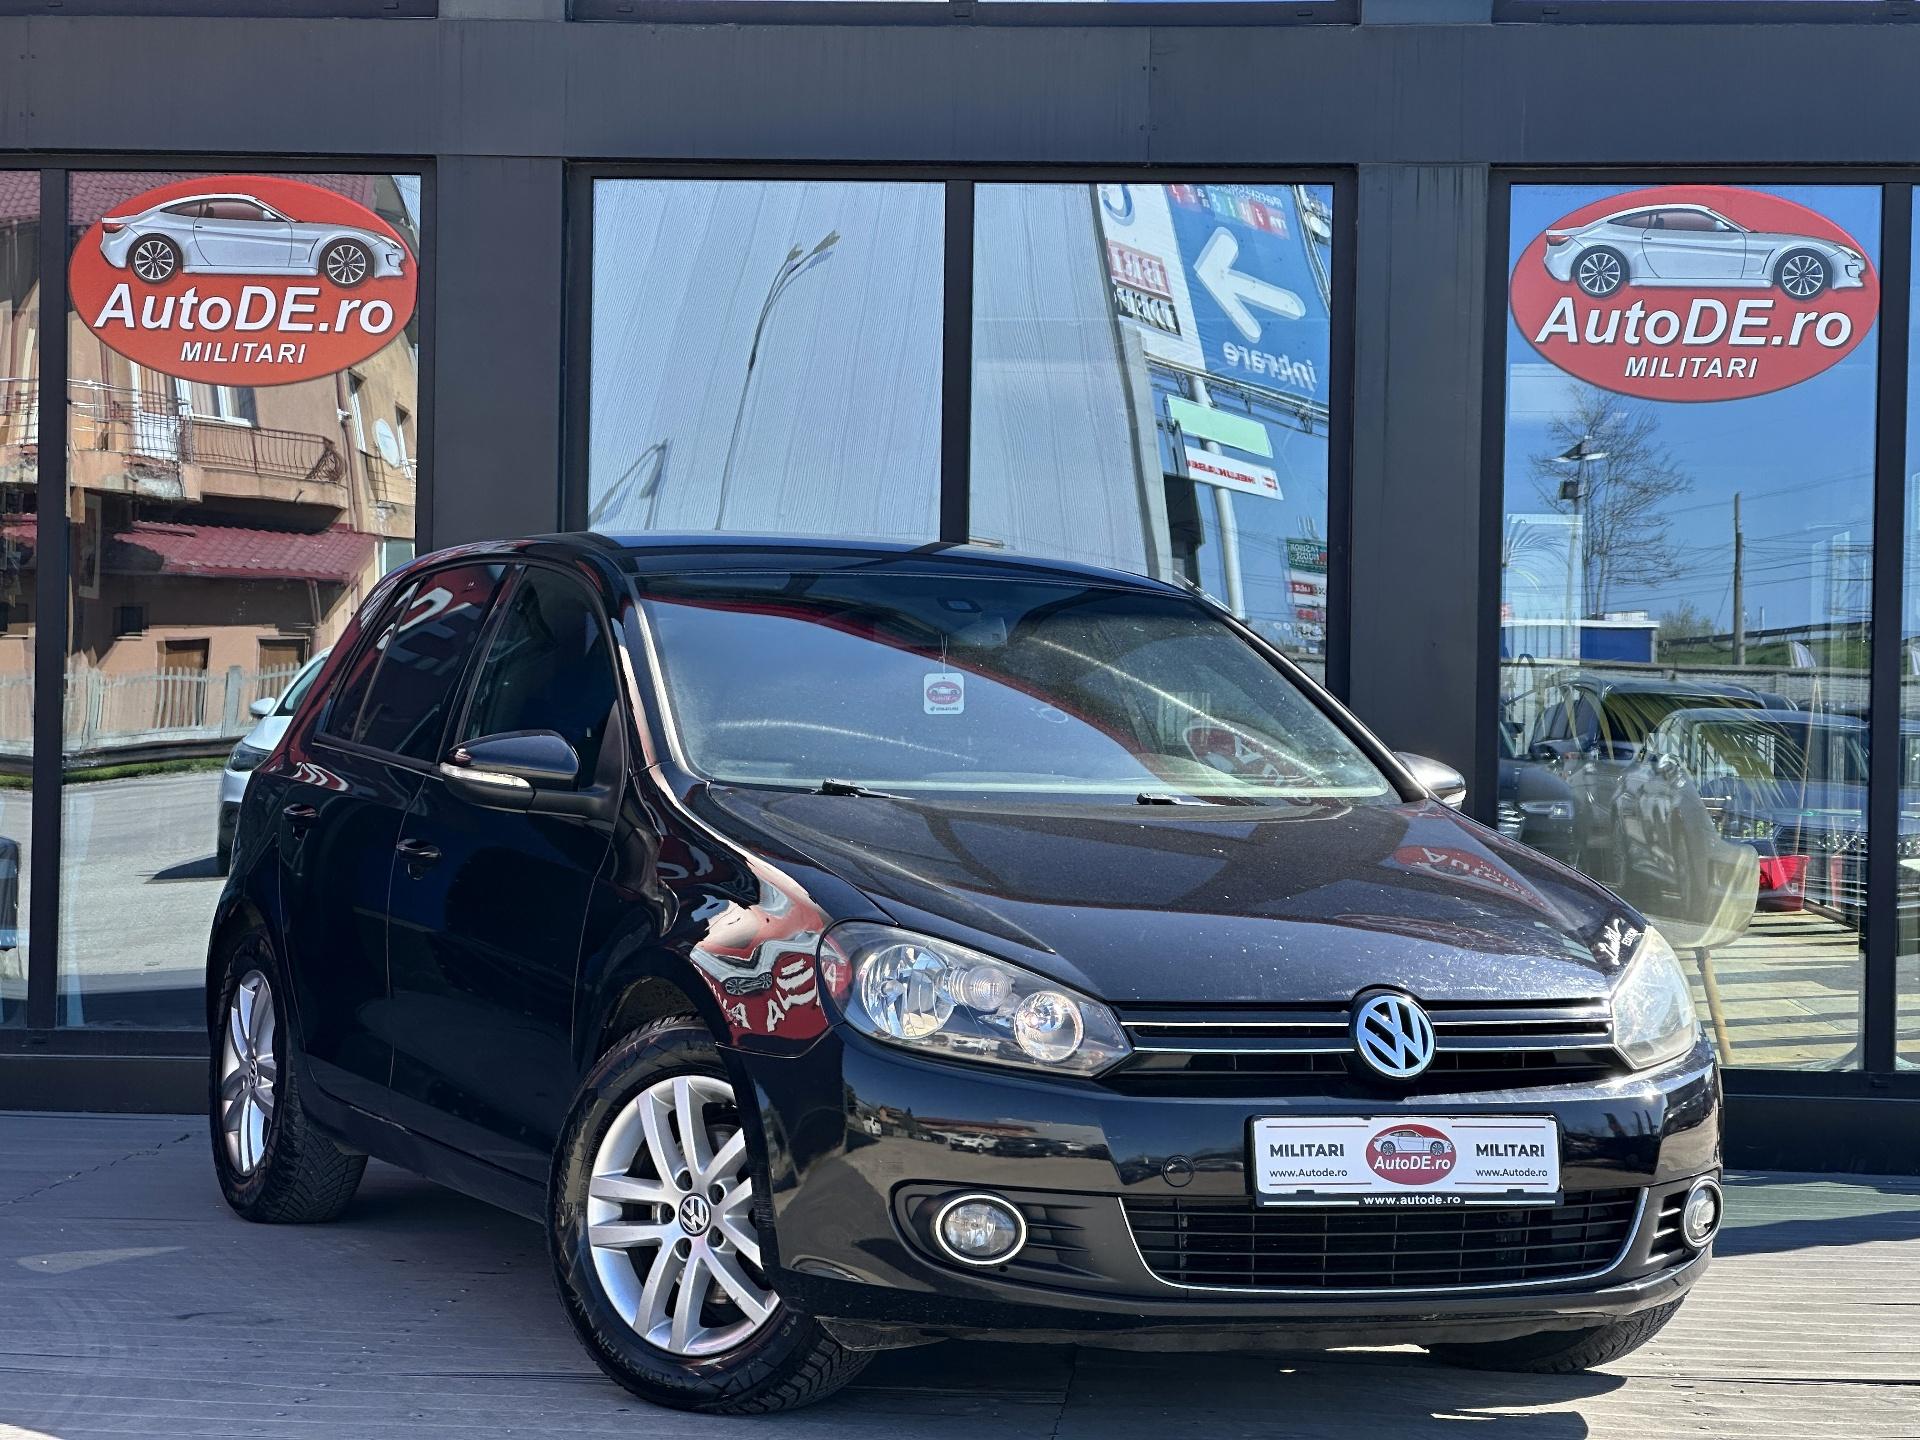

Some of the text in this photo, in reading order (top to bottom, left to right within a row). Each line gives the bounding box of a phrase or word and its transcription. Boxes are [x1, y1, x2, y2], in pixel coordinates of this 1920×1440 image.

[93, 283, 394, 334] AutoDE.ro
[1535, 297, 1853, 348] AutoDE.ro
[180, 341, 307, 364] MILITARI
[1624, 356, 1758, 379] MILITARI
[1269, 1143, 1345, 1157] MILITARI
[1475, 1143, 1546, 1157] MILITARI
[1373, 1155, 1451, 1171] AutoDE.ro
[1269, 1168, 1348, 1178] www.Autode.ro
[1475, 1167, 1548, 1178] www.Autode.ro
[1363, 1195, 1461, 1206] www.autode.ro
